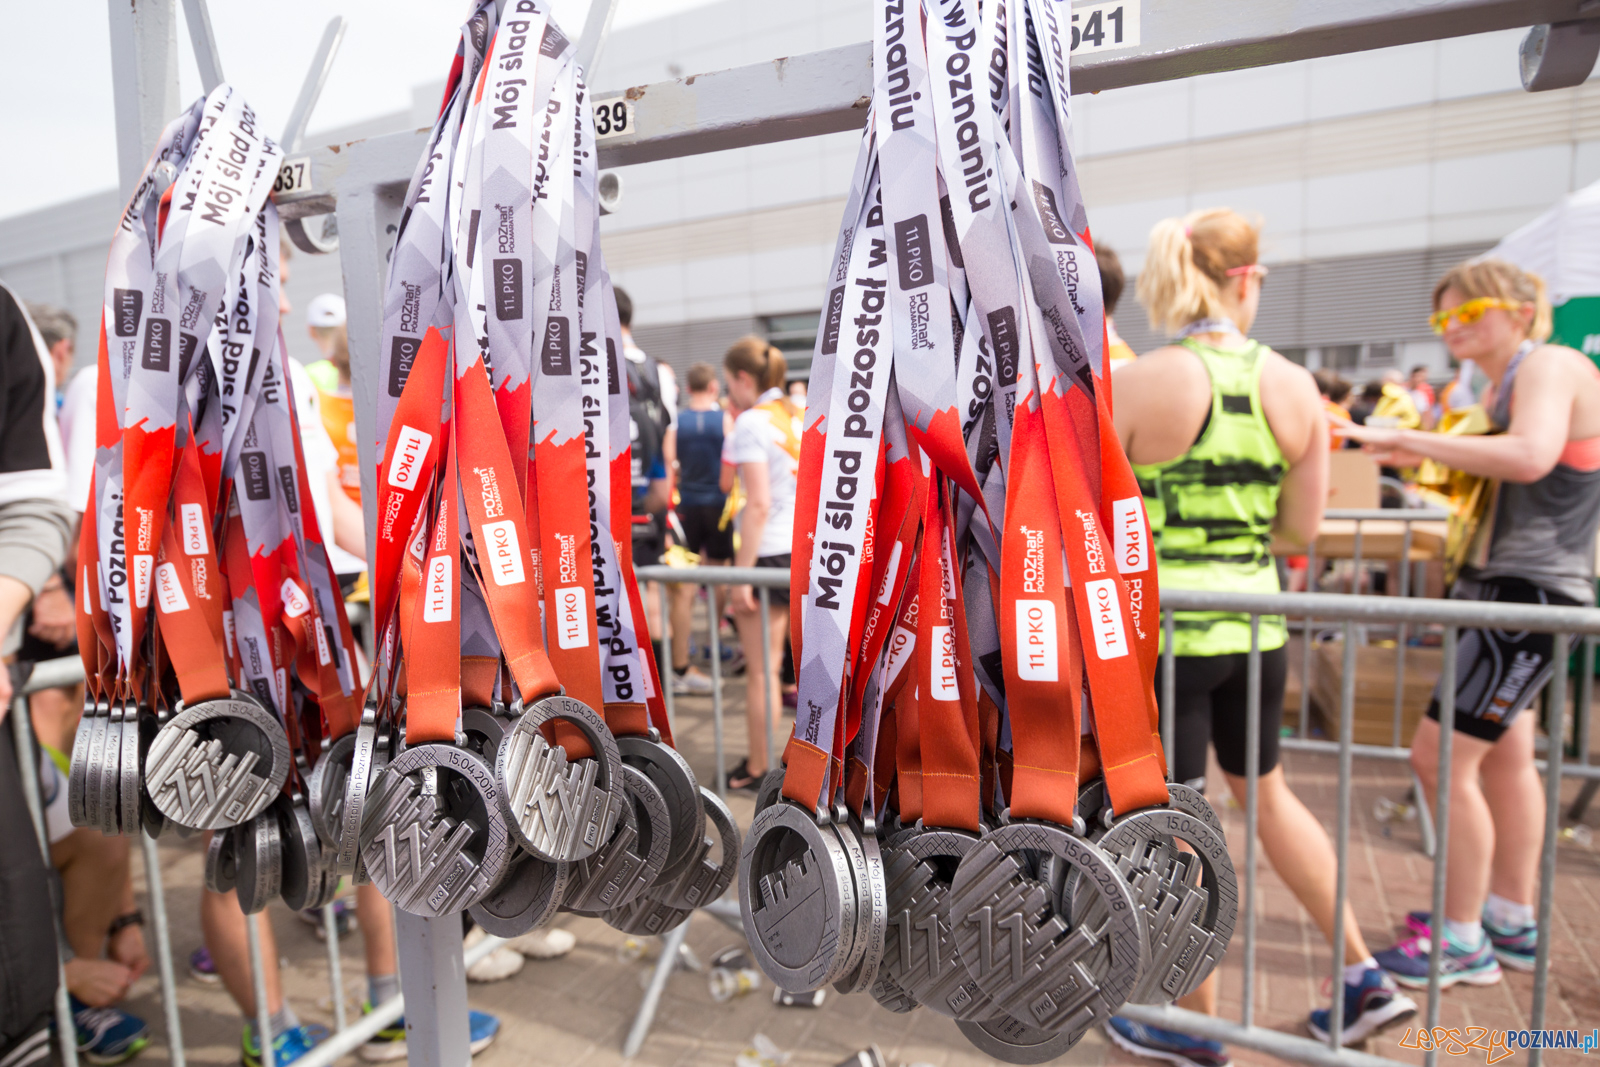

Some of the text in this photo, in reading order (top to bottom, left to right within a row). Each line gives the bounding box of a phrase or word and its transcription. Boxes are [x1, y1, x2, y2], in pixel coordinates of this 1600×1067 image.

[500, 20, 531, 72] ślad
[886, 0, 922, 132] znaniu
[492, 78, 527, 130] Mój
[588, 101, 628, 136] 39
[945, 27, 994, 213] Poznaniu
[217, 131, 250, 181] ślad
[200, 177, 243, 226] Mój
[1039, 193, 1052, 218] 11.
[1045, 213, 1066, 239] PKO
[906, 226, 924, 282] 11. PKO
[502, 264, 514, 312] 11. PKO
[548, 321, 561, 348] PKO
[996, 318, 1006, 340] 11.
[550, 352, 562, 368] 11.
[844, 278, 888, 438] pozostał
[1000, 342, 1014, 379] PKO
[396, 438, 420, 483] 11. PKO
[824, 450, 862, 531] ślad
[494, 527, 514, 576] 11. PKO
[1126, 508, 1140, 567] 11. PKO
[433, 562, 445, 613] 11. PKO
[815, 540, 856, 610] Mój
[564, 592, 580, 640] 11. PKO
[1028, 607, 1044, 670] 11. PKO
[1096, 587, 1117, 648] 11. PKO
[942, 671, 954, 691] 11.
[561, 700, 605, 734] 15.04.2018
[448, 751, 497, 800] 15.04.2018
[526, 773, 576, 849] 11
[588, 826, 596, 842] PKO
[374, 822, 422, 889] 11
[852, 847, 864, 870] Mój
[1166, 816, 1223, 860] 15.04.2018
[602, 886, 614, 900] PKO
[871, 858, 880, 880] Mój
[1064, 840, 1126, 912] 15.04.2018
[431, 890, 446, 905] PKO
[968, 906, 1023, 982] 11
[952, 992, 966, 1008] PKO
[1168, 970, 1181, 988] PKO
[1035, 1000, 1051, 1016] PKO
